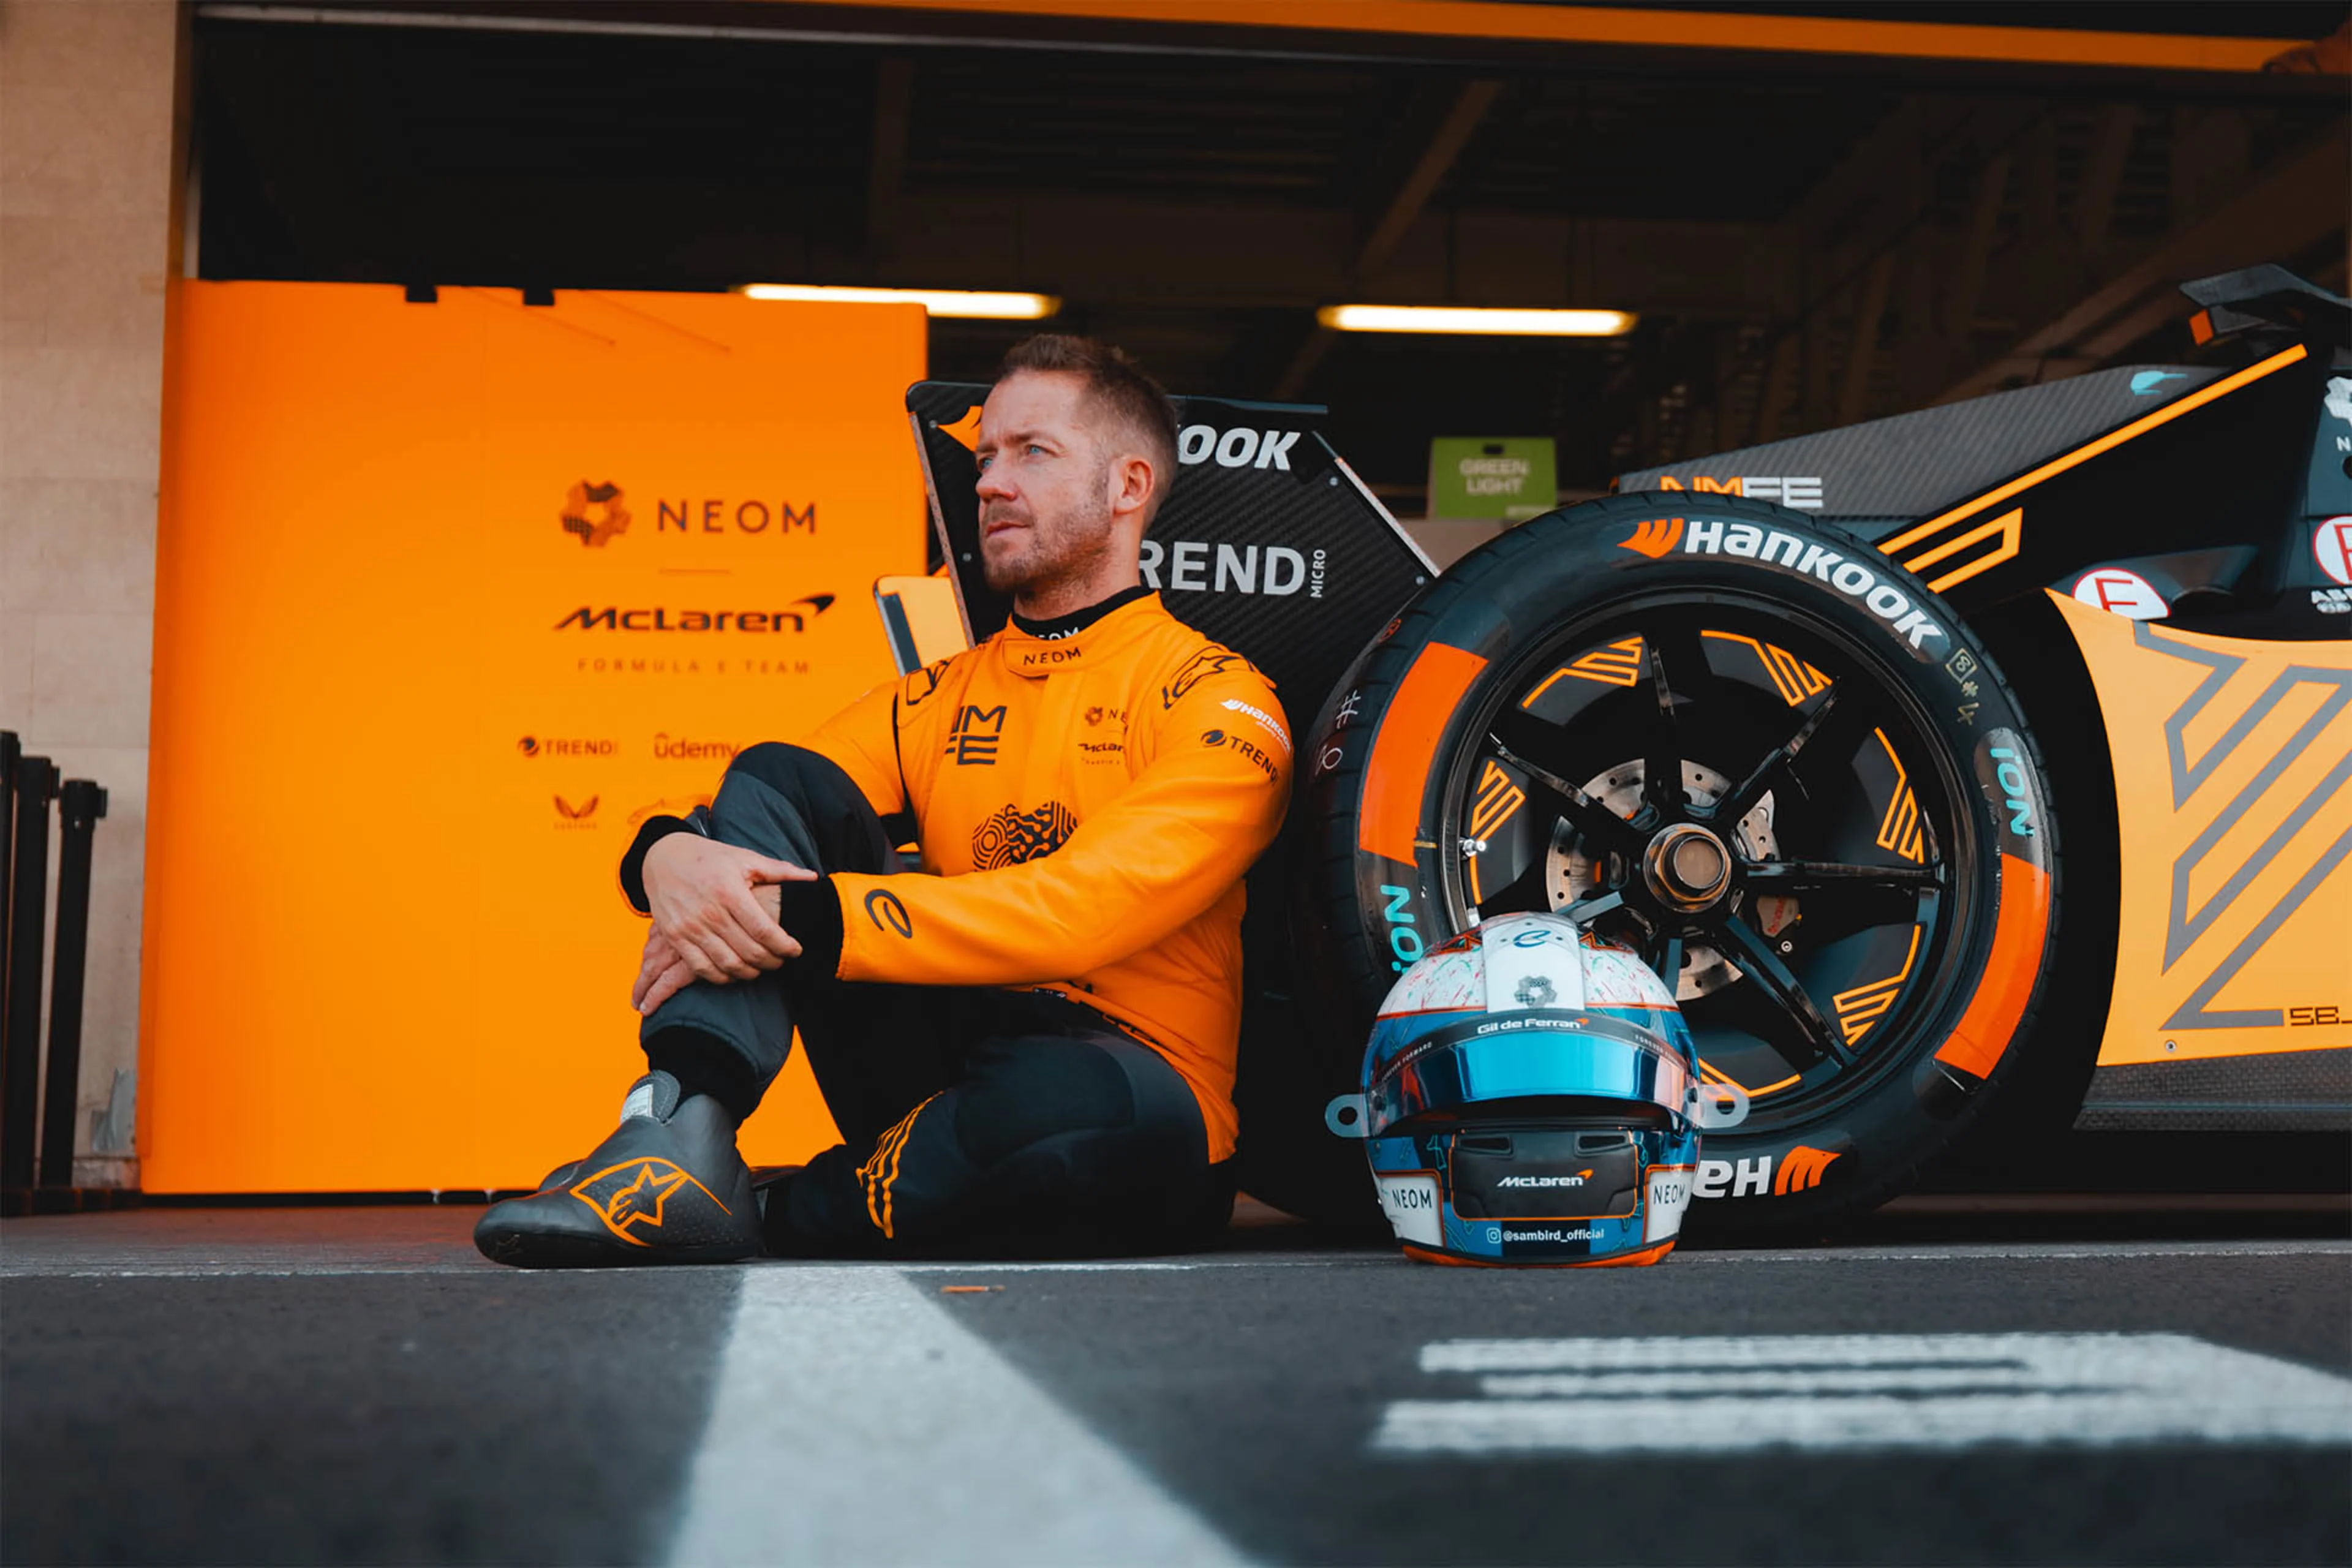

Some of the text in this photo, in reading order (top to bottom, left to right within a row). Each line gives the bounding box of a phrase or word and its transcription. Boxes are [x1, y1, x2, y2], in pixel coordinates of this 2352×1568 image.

[1178, 424, 1301, 471] OOK
[1459, 458, 1529, 475] GREEN
[1466, 477, 1523, 495] LIGHT
[658, 500, 816, 535] NEOM
[1139, 540, 1306, 596] REND
[1310, 549, 1327, 598] MICRO
[553, 606, 805, 633] McLaren
[578, 658, 810, 674] FORMULA E TEAM
[1023, 647, 1081, 666] NEOM
[545, 739, 612, 756] TREND
[1231, 736, 1278, 783] TREND
[1477, 1018, 1581, 1035] Gil de Ferran
[1497, 1176, 1585, 1188] McLaren
[1392, 1188, 1433, 1208] NEOM
[1502, 1227, 1605, 1243] @sambird_official
